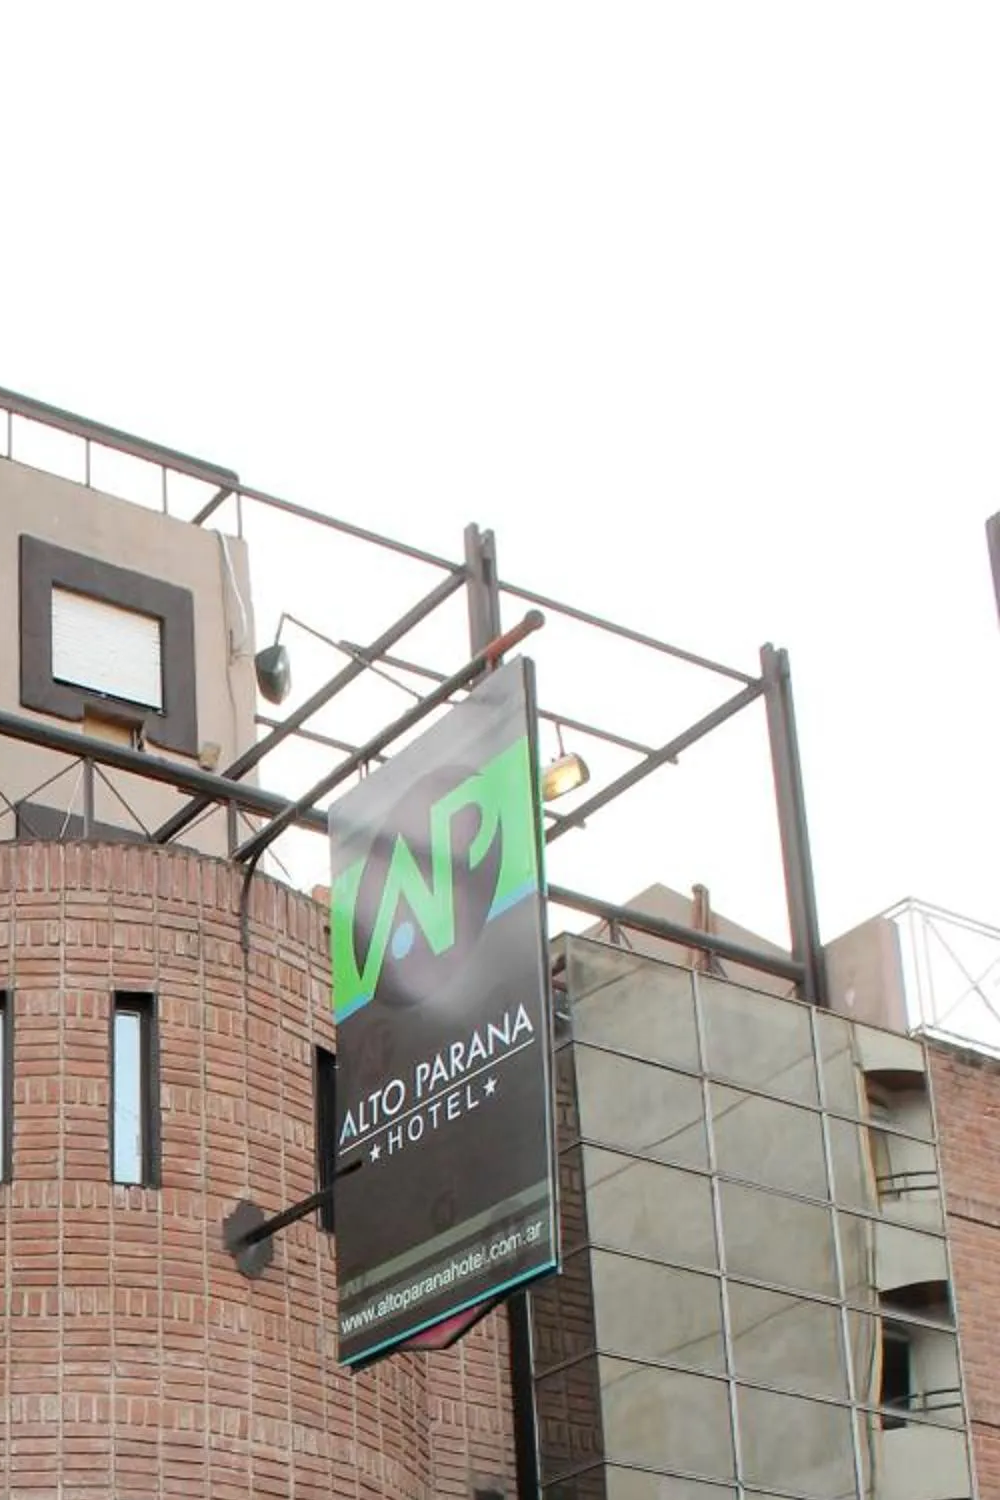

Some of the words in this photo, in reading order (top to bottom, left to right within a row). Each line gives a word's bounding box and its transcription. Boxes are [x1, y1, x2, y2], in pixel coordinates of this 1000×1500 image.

[339, 1079, 406, 1146] ALTO
[415, 1002, 535, 1098] PARANA
[388, 1084, 480, 1155] HOTEL
[340, 1220, 544, 1334] www.altoparanahotel.com.ar
